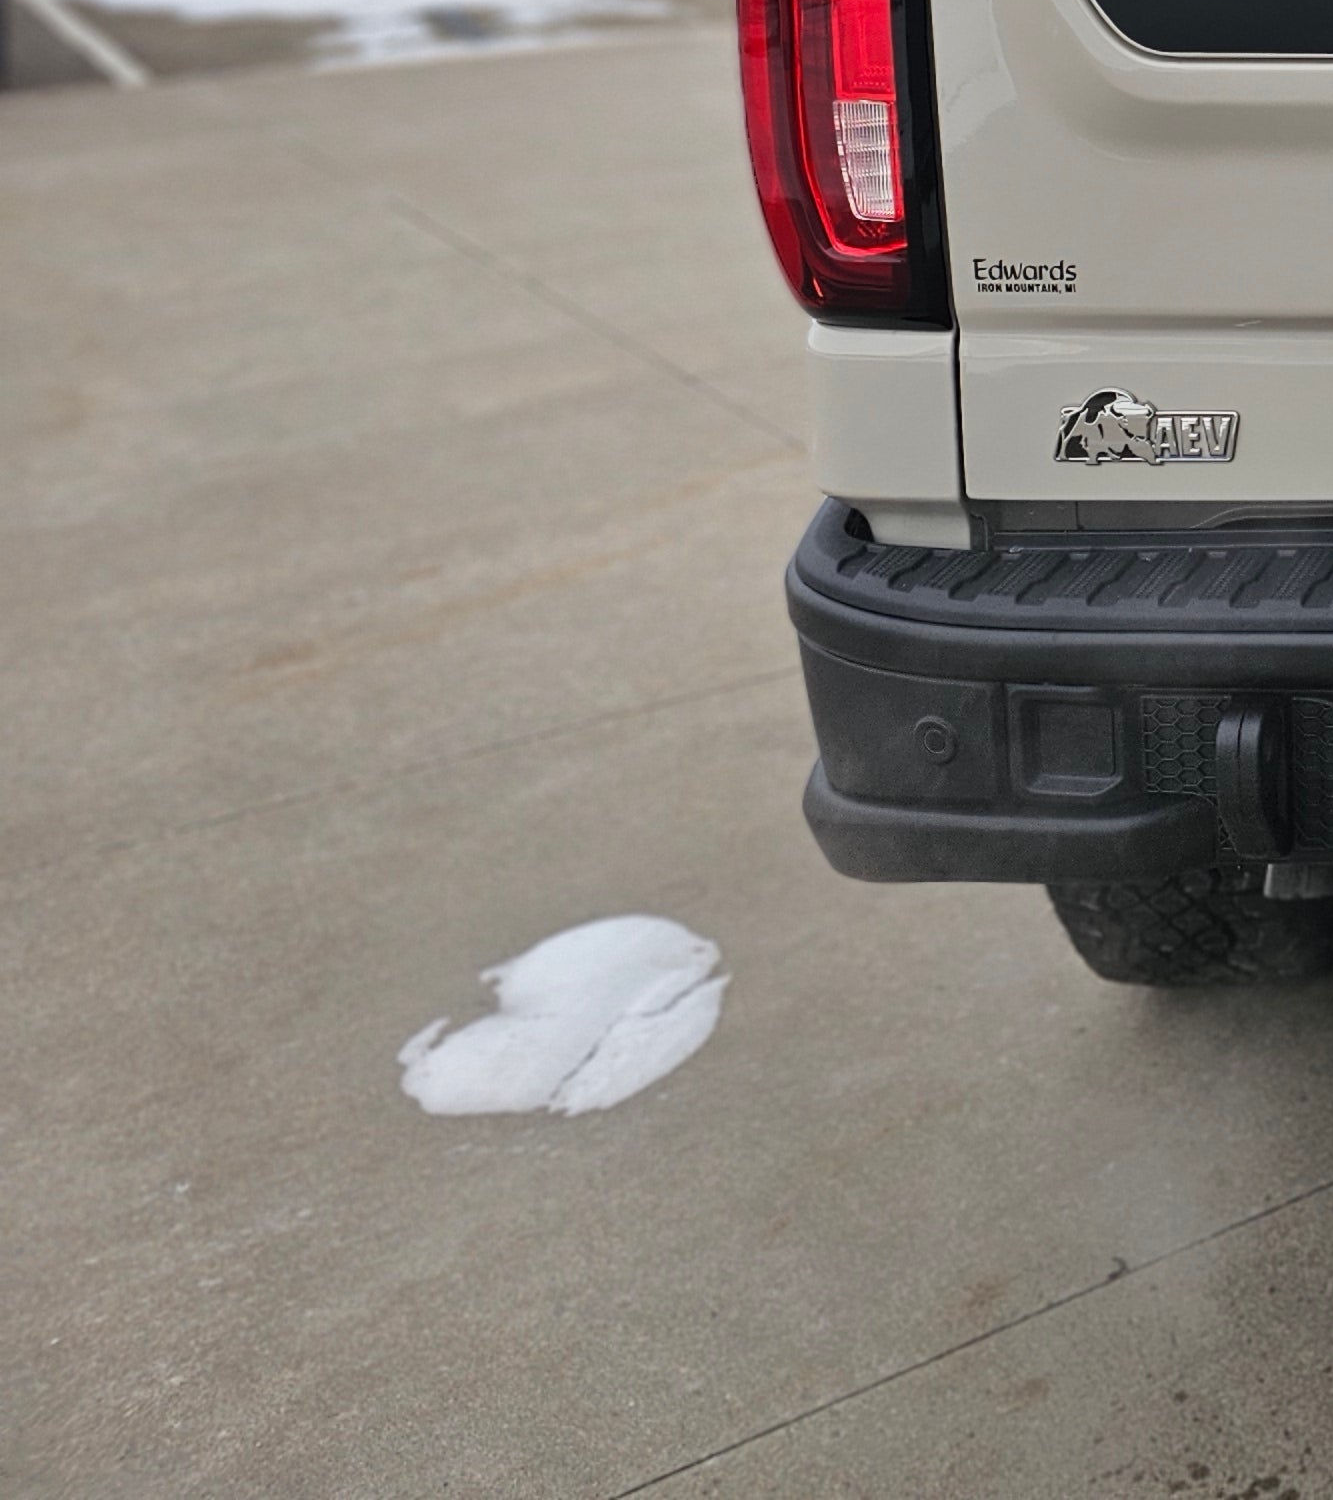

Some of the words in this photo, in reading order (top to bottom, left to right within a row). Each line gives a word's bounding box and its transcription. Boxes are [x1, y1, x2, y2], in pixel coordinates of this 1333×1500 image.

[972, 258, 1077, 281] Edwards
[977, 283, 1003, 293] IRON
[1005, 283, 1062, 295] MOUNTAIN,
[1064, 283, 1077, 293] MI
[1154, 417, 1232, 458] AEV
